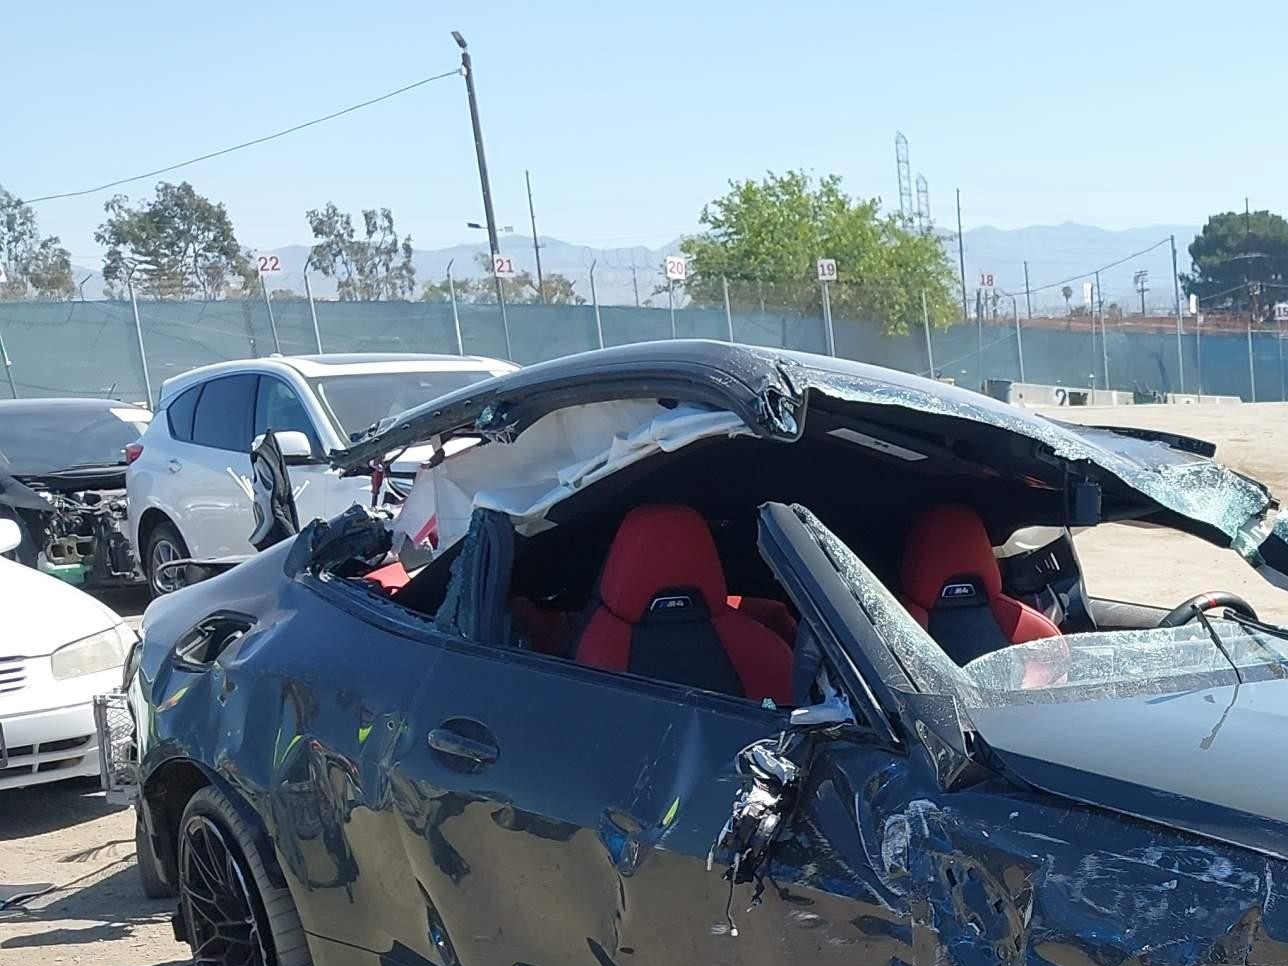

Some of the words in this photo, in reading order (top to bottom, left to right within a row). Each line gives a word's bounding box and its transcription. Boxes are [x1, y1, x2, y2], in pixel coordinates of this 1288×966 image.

[258, 256, 281, 271] 22
[495, 258, 513, 273] 21
[668, 260, 684, 275] 20
[820, 263, 835, 276] 19
[980, 274, 994, 286] 18
